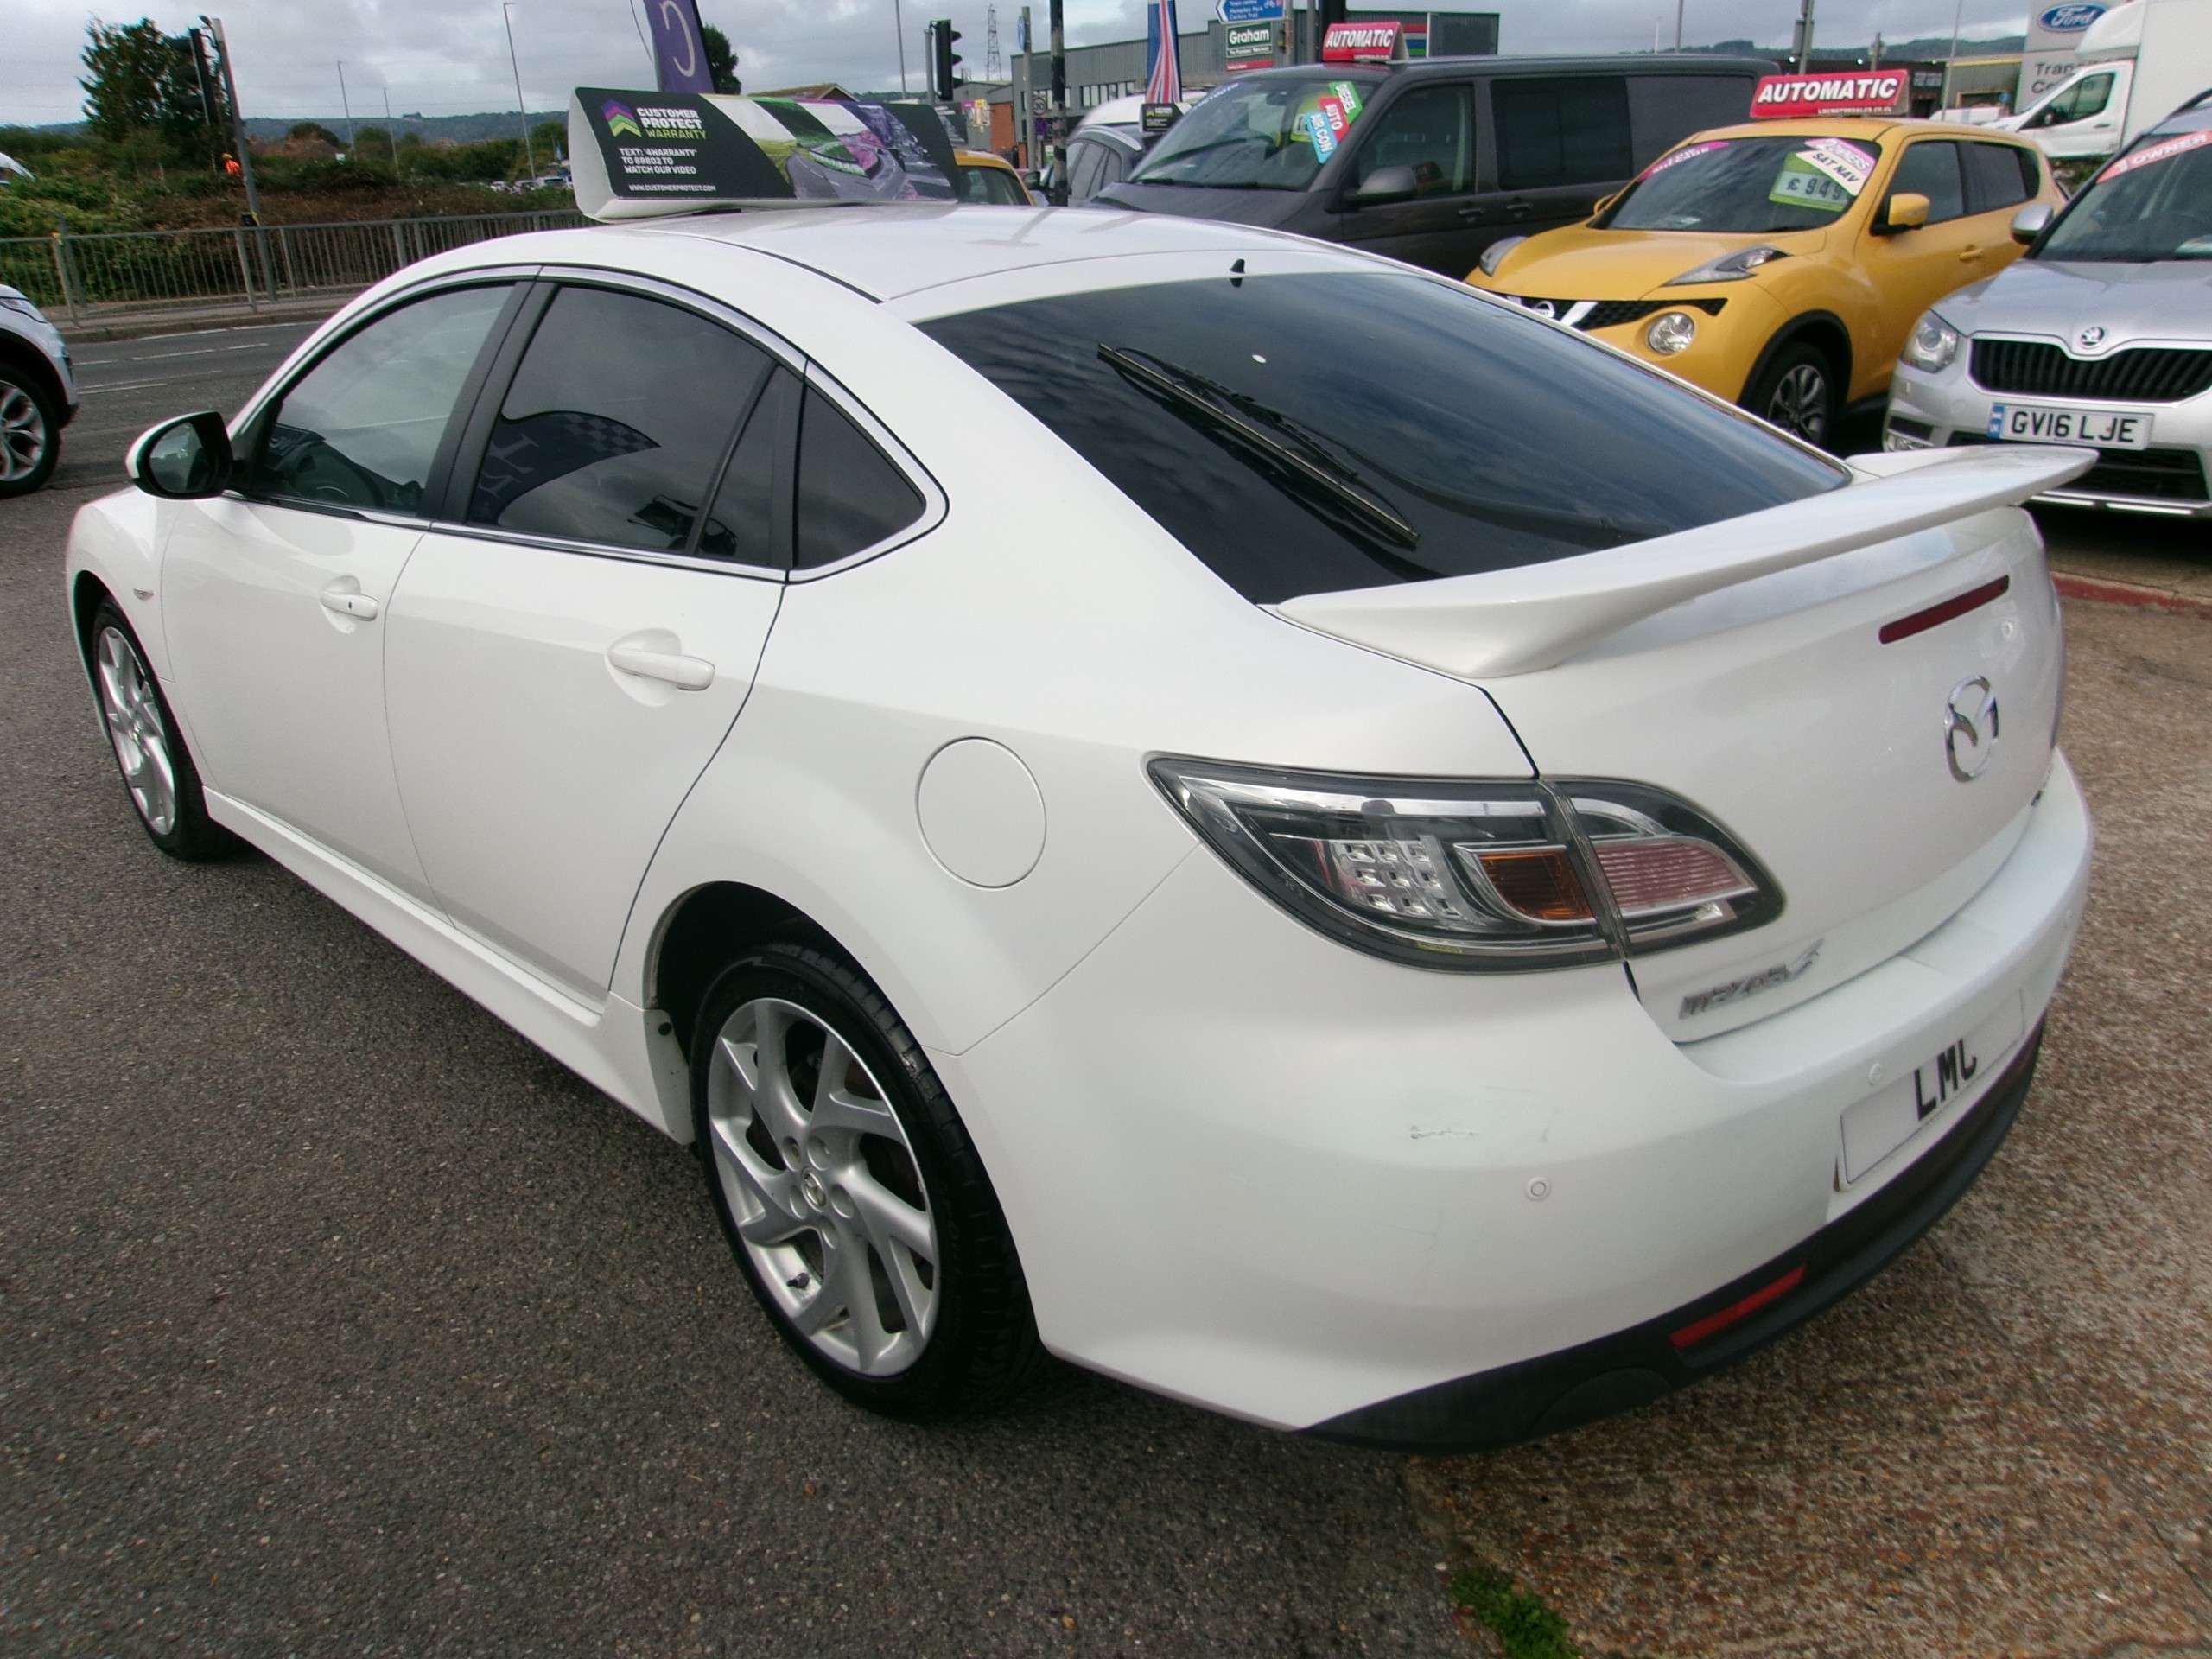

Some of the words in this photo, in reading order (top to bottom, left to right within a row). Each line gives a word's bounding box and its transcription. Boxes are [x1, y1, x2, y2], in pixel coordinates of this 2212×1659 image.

[2050, 5, 2099, 27] Ford
[1229, 29, 1269, 45] Graham
[1325, 29, 1394, 48] AUTOMATIC
[1757, 78, 1898, 104] AUTOMATIC
[636, 107, 700, 119] CUSTOMER
[640, 117, 702, 130] PROTECT
[645, 128, 707, 139] WARRANTY
[619, 148, 644, 156] TEXT:
[621, 156, 633, 165] TO
[1813, 153, 1837, 166] SAT
[1834, 165, 1859, 182] NAV
[623, 165, 653, 174] WATCH
[671, 166, 697, 175] VIDEO
[2012, 411, 2071, 438] GV16
[2079, 416, 2139, 443] LJE
